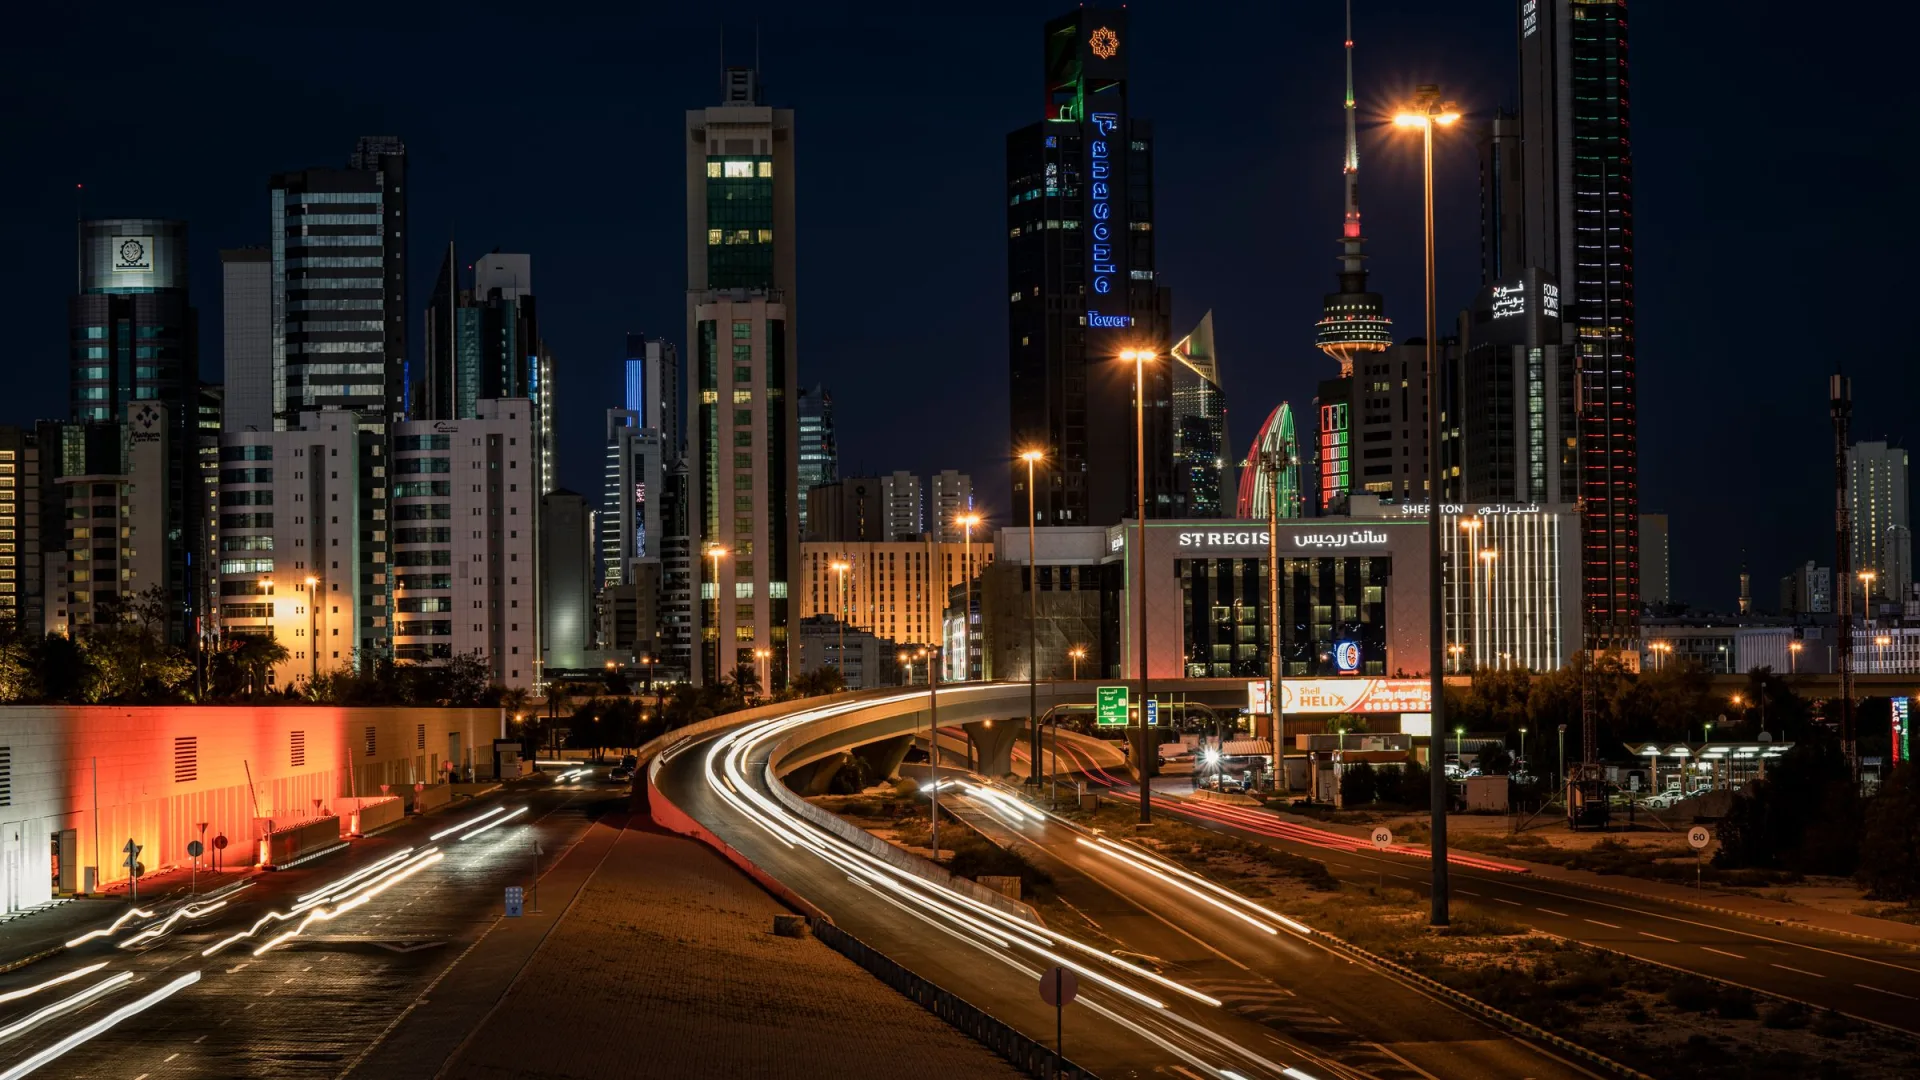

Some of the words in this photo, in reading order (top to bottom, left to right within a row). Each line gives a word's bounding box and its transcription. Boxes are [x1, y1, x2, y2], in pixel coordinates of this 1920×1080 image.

[1092, 112, 1118, 293] Panasonic
[1543, 283, 1558, 297] FOUR
[1492, 296, 1524, 310] بوينتس
[1087, 310, 1130, 327] Tower
[1493, 307, 1524, 319] شيراتون
[1401, 504, 1463, 514] SHERTON
[1478, 501, 1539, 515] شيراتون
[1207, 532, 1270, 545] REGIS
[1294, 533, 1348, 547] ريجيس
[1349, 530, 1387, 544] سانت
[1300, 687, 1320, 695] Shell
[1300, 692, 1350, 707] HELIX
[1376, 833, 1388, 841] 60
[1693, 833, 1705, 841] 60
